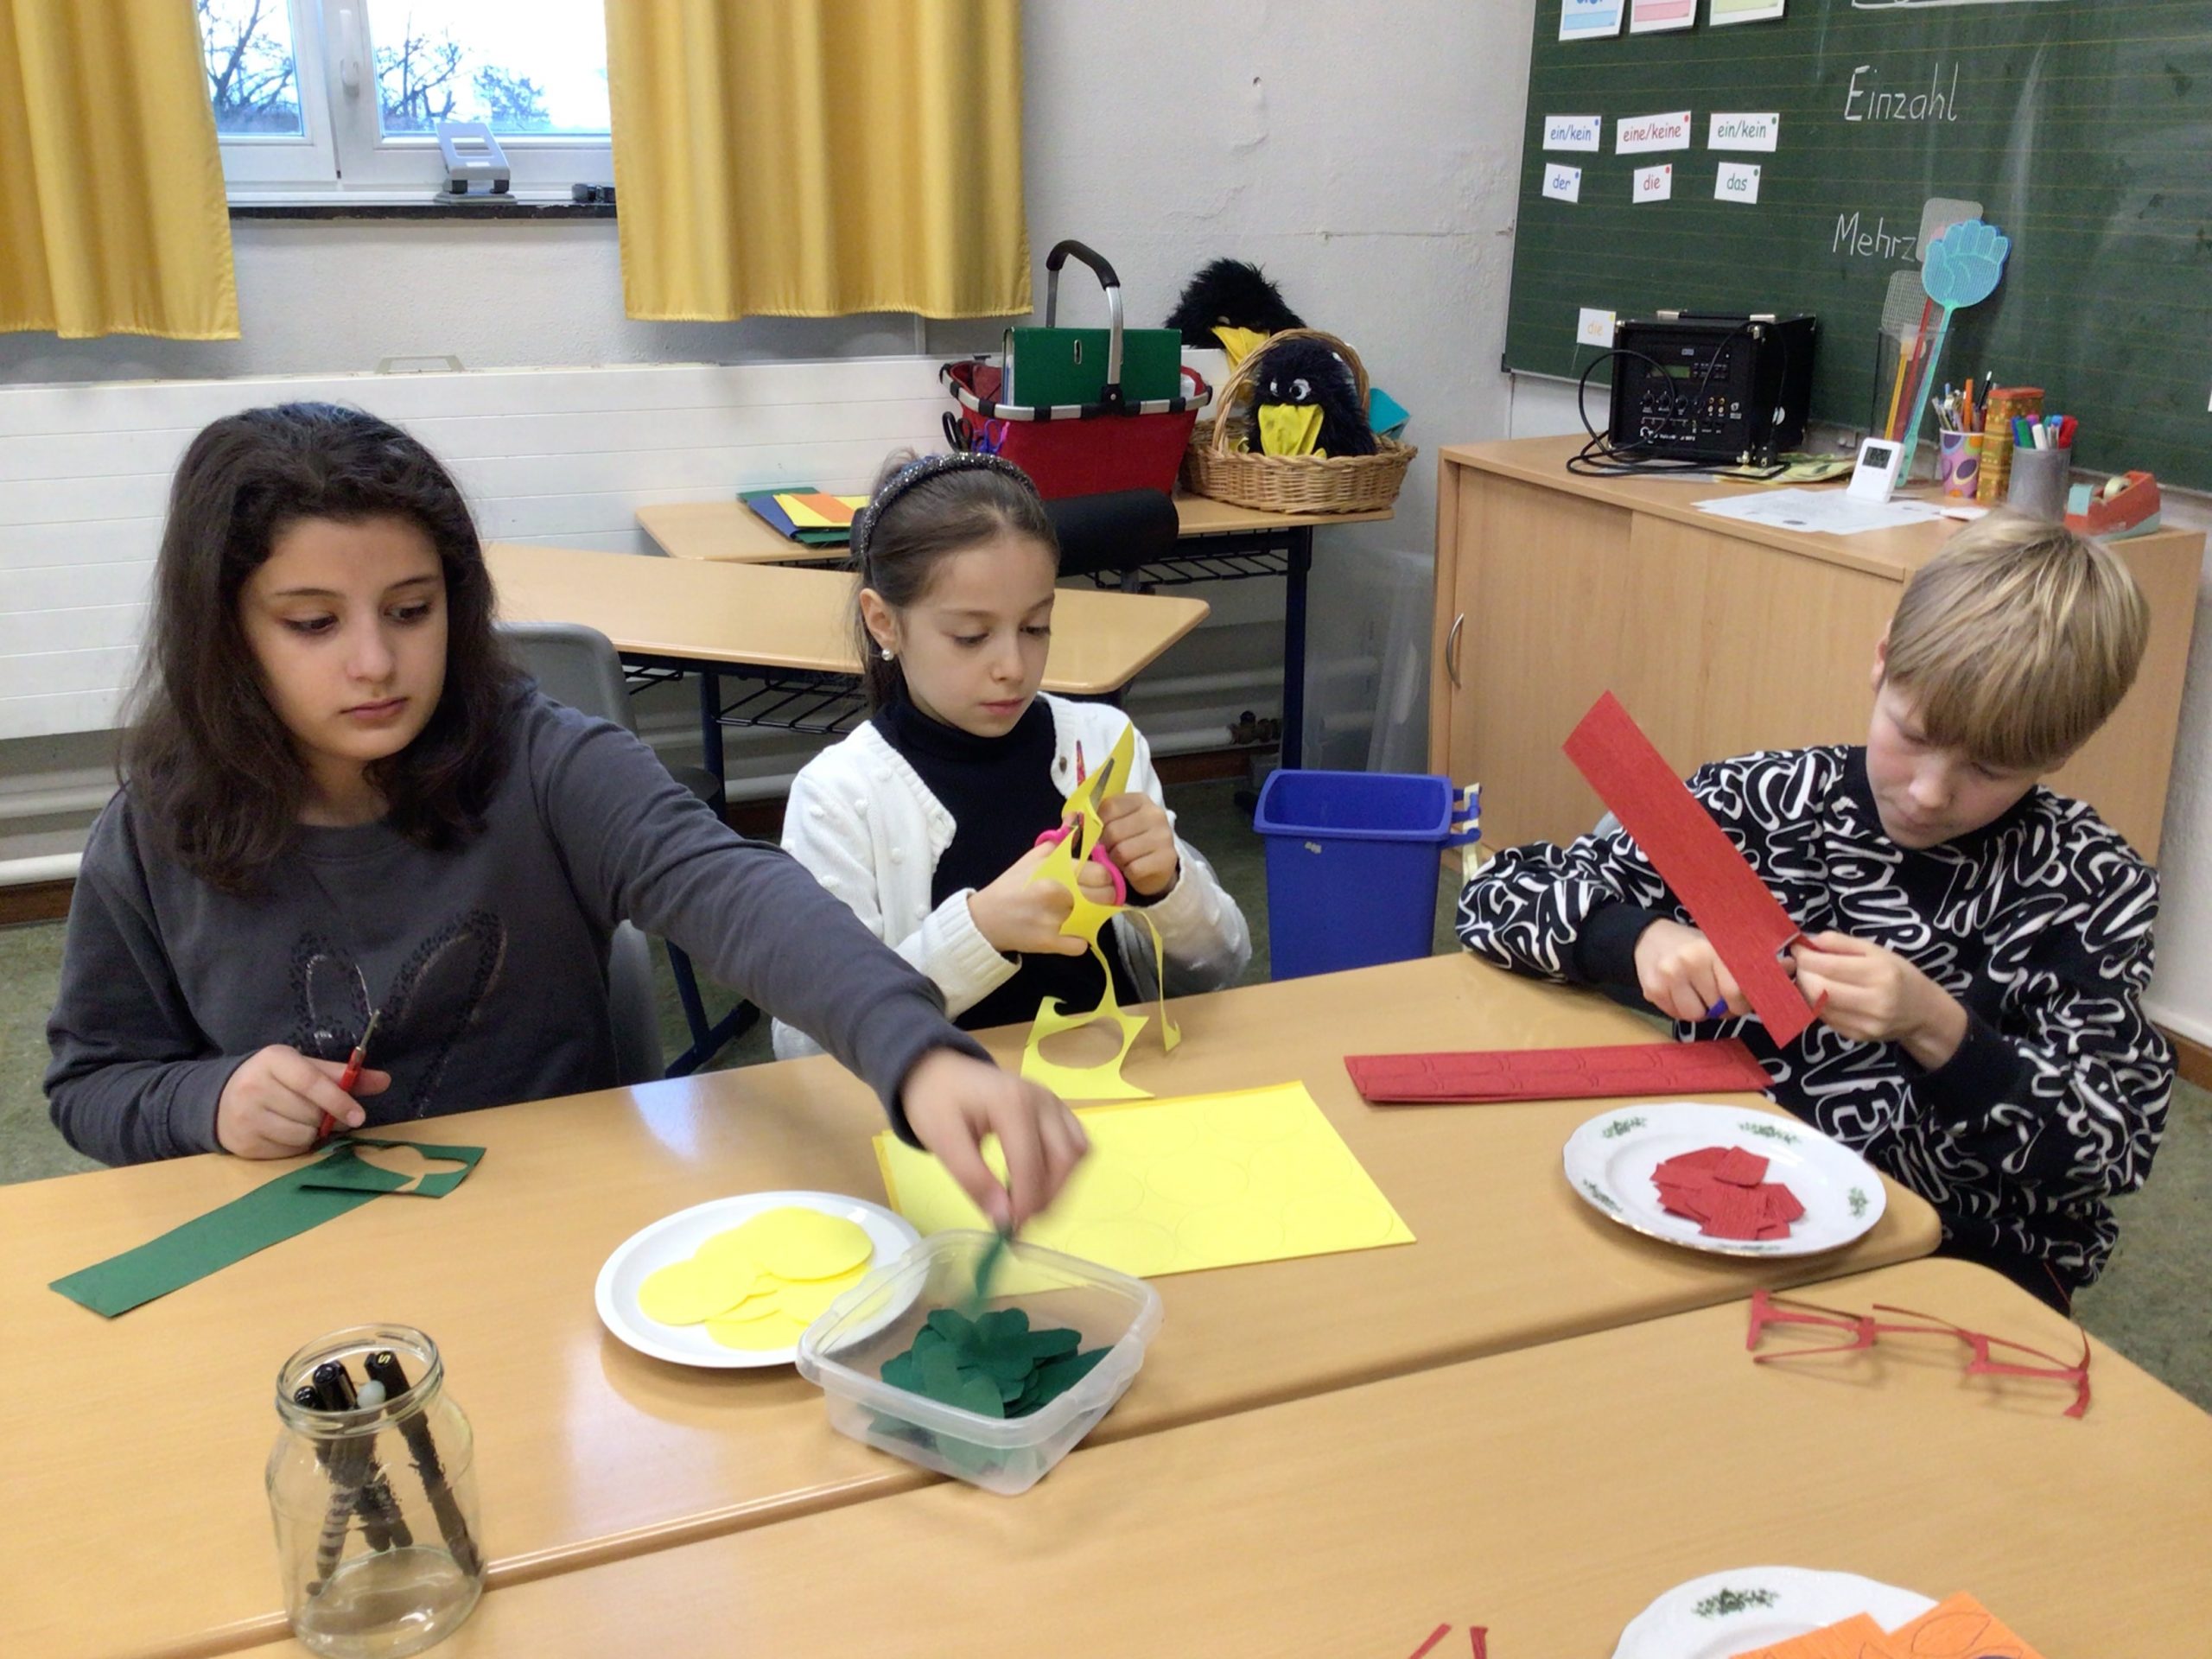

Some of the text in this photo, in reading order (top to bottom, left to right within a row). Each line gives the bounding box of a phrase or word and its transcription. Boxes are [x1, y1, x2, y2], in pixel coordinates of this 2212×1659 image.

[1844, 61, 1959, 122] Einzahl
[1550, 124, 1592, 141] ein/kein
[1623, 123, 1681, 143] eine/keine
[1718, 119, 1767, 138] ein/kein
[1552, 174, 1571, 191] der
[1643, 175, 1661, 191] die
[1726, 174, 1748, 191] das
